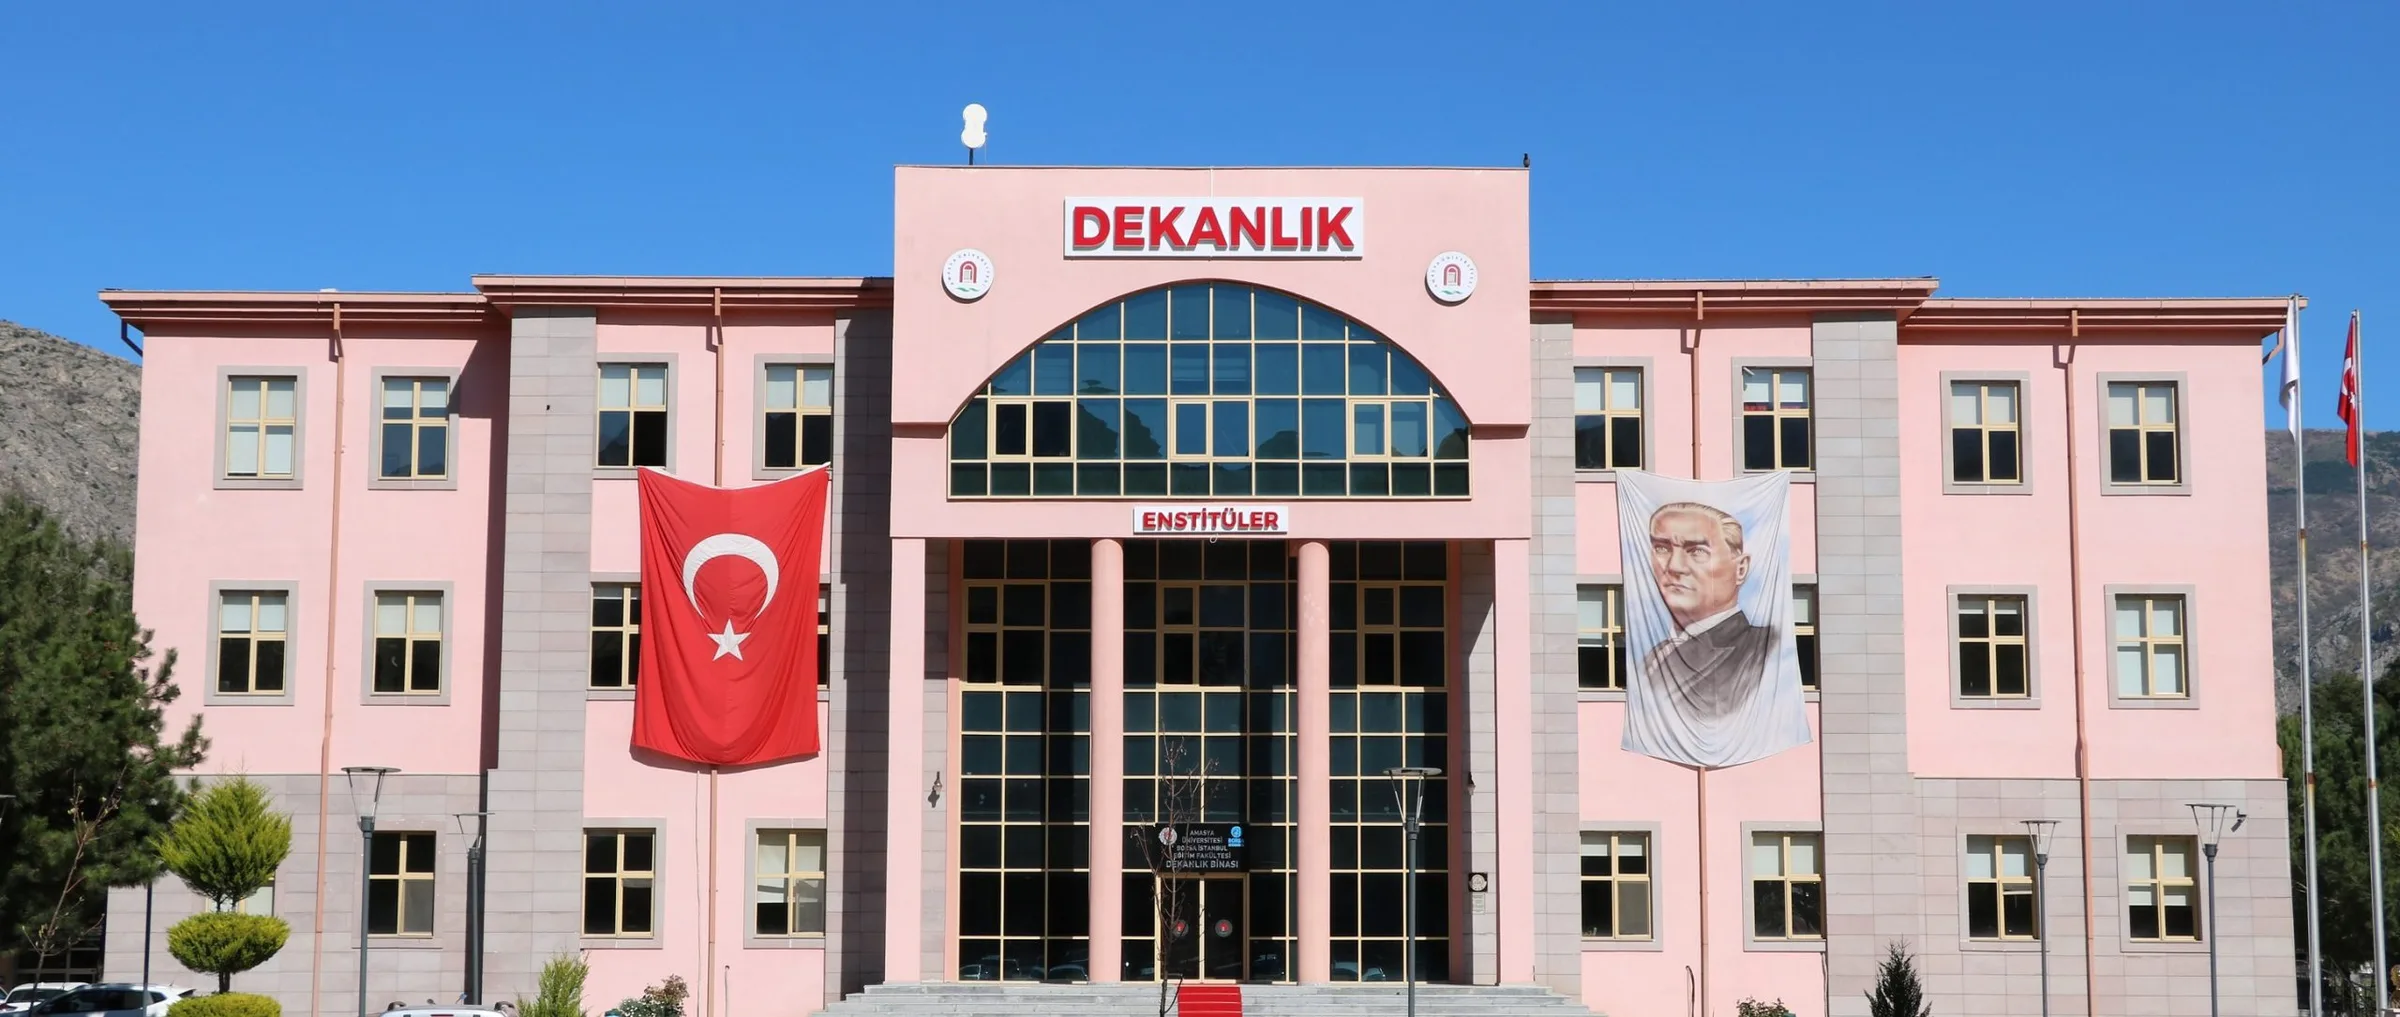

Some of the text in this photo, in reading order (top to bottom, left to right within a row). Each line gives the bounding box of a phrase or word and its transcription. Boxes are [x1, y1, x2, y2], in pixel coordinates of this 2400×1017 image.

[1072, 206, 1355, 250] DEKANLIK
[1142, 508, 1279, 530] ENSTİTÜLER
[1210, 860, 1239, 868] BİNASI
